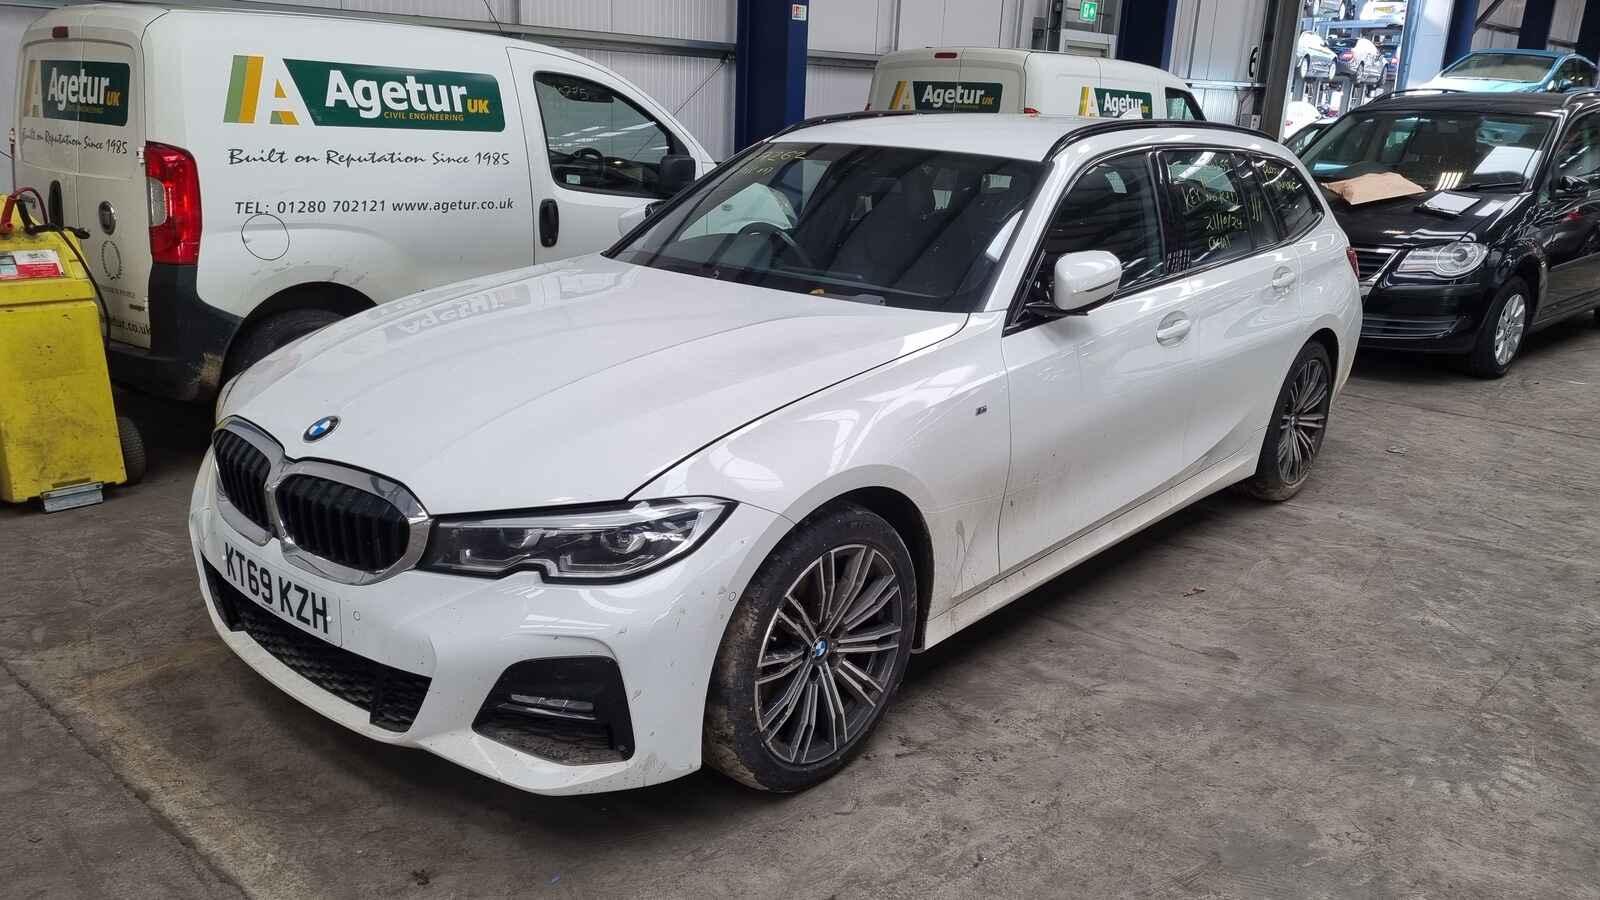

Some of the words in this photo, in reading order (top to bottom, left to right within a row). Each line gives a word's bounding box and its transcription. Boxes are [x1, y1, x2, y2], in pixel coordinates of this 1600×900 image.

[48, 67, 110, 111] Agetur
[325, 69, 467, 119] Agetur
[467, 98, 490, 113] UK
[922, 84, 984, 108] Agetur
[384, 111, 406, 120] CIVIL
[409, 112, 464, 121] ENGINEERING
[1103, 92, 1144, 116] Agetur
[83, 136, 104, 149] Since
[105, 138, 128, 154] 1985
[228, 148, 288, 165] Built
[295, 154, 320, 163] on
[326, 149, 427, 168] Reputation
[432, 151, 471, 165] Since
[475, 151, 510, 166] 1985
[235, 200, 270, 214] TEL:
[277, 201, 326, 213] 01280
[333, 200, 385, 212] 702121
[392, 197, 514, 213] www.agetur.co.uk
[224, 542, 273, 605] KT69
[278, 575, 329, 634] KZH
